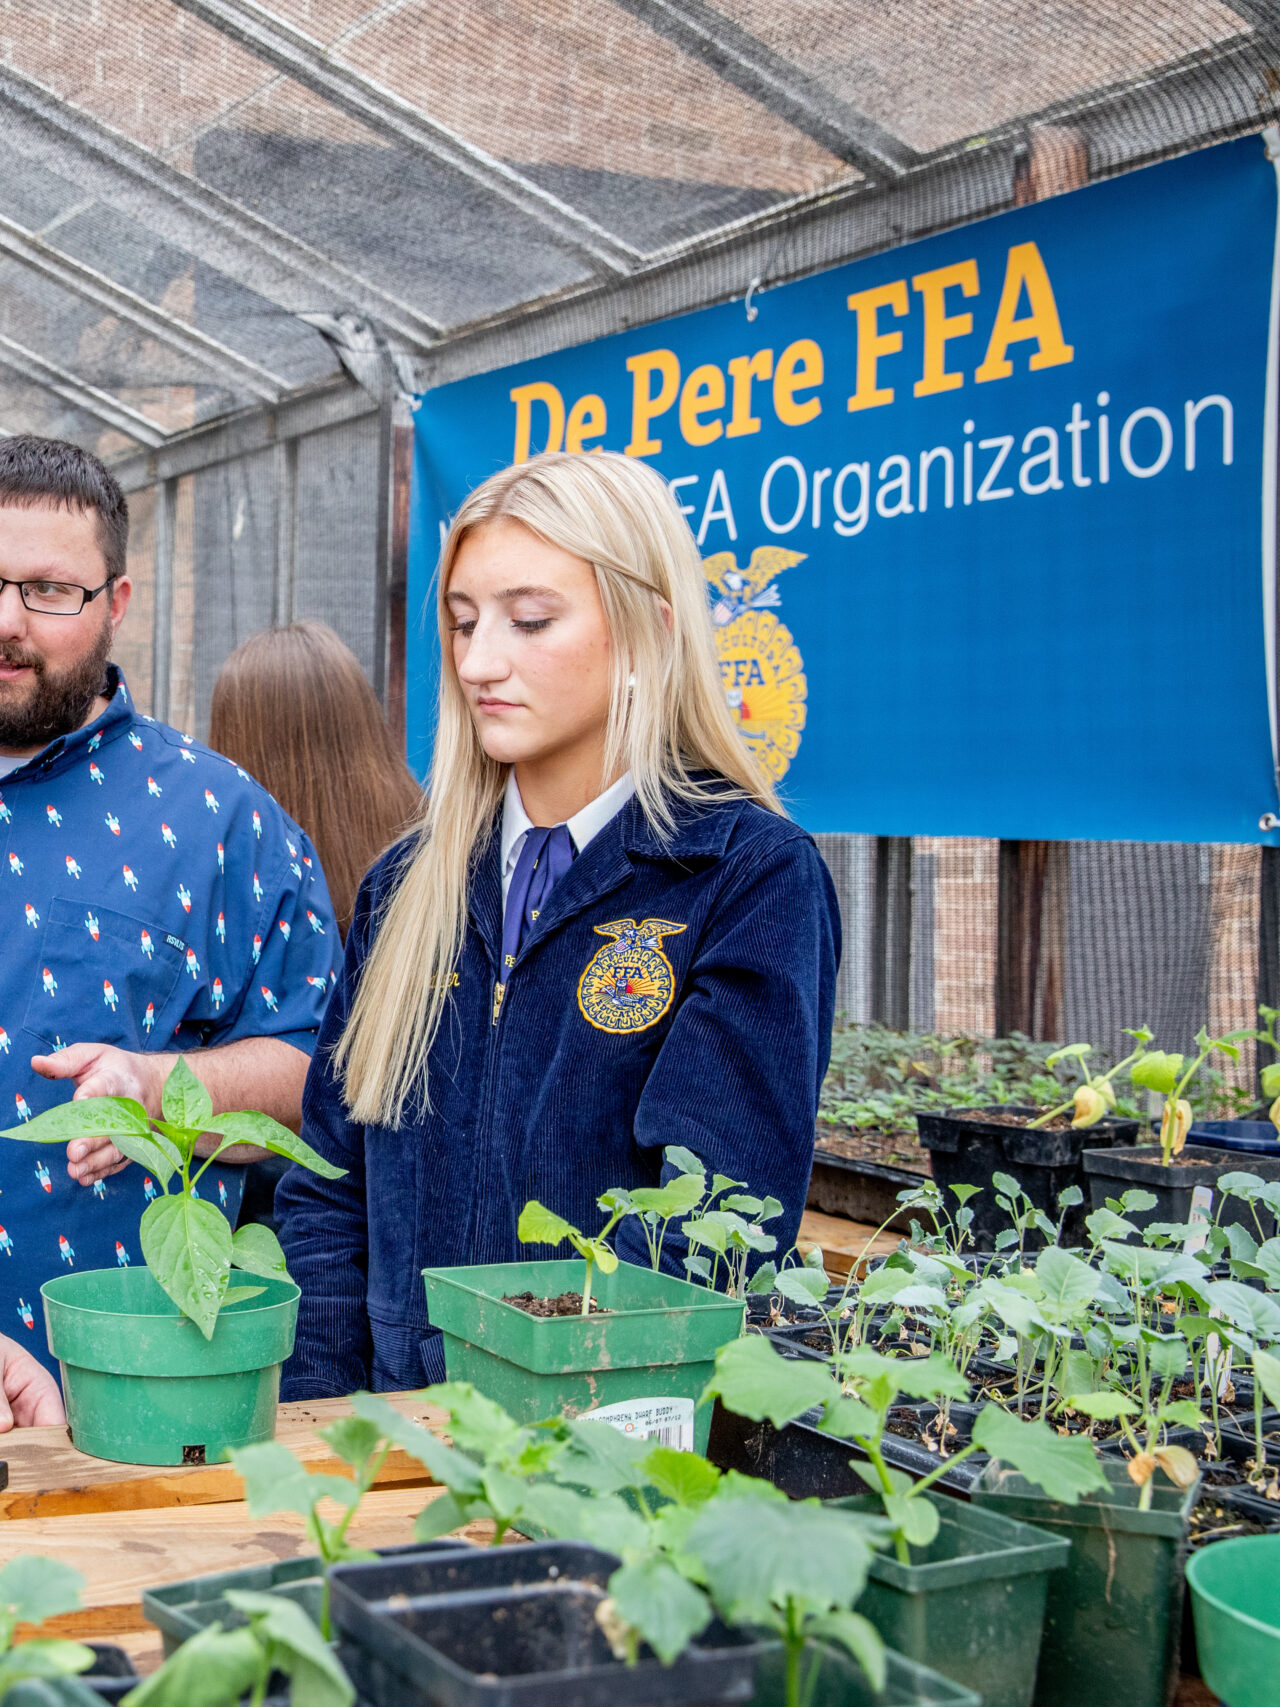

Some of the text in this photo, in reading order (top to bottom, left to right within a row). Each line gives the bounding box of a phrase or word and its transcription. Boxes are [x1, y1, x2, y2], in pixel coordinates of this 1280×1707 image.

[510, 241, 1074, 466] De Pere FFA
[670, 391, 1234, 546] FA Organization
[505, 955, 516, 968] FF
[611, 966, 644, 979] FFA
[596, 999, 651, 1018] EDUCATION
[655, 1406, 673, 1416] BUDDY
